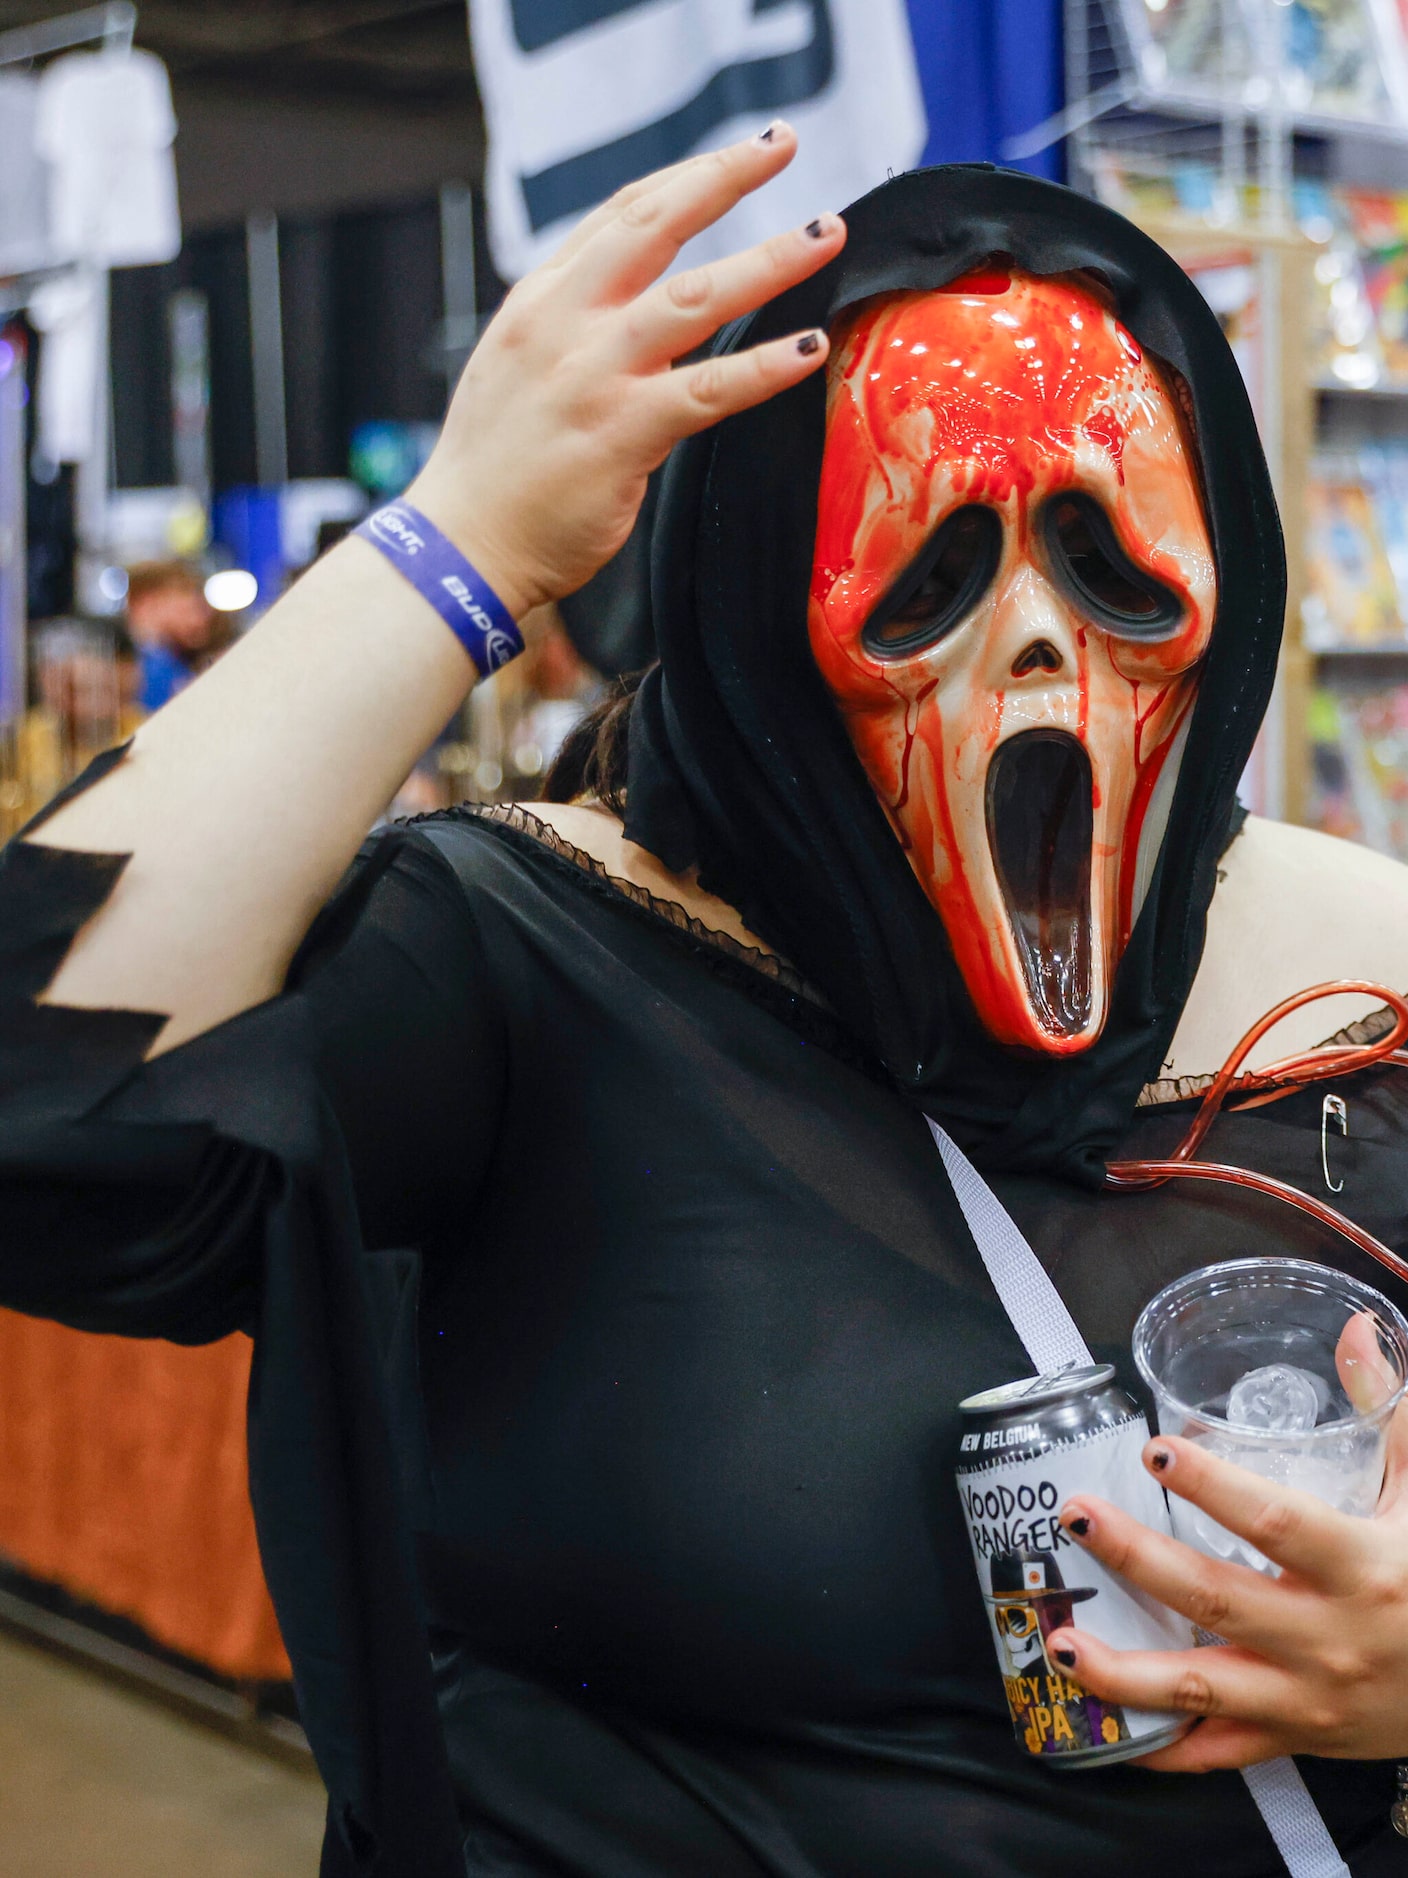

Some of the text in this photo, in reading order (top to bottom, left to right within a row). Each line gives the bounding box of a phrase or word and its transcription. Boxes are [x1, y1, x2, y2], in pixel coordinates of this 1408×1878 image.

[441, 575, 493, 632] BUD
[960, 1431, 980, 1452] NEW
[961, 1481, 1058, 1521] VOODOO
[971, 1515, 1071, 1561] RANGER
[1028, 1704, 1075, 1743] IPA
